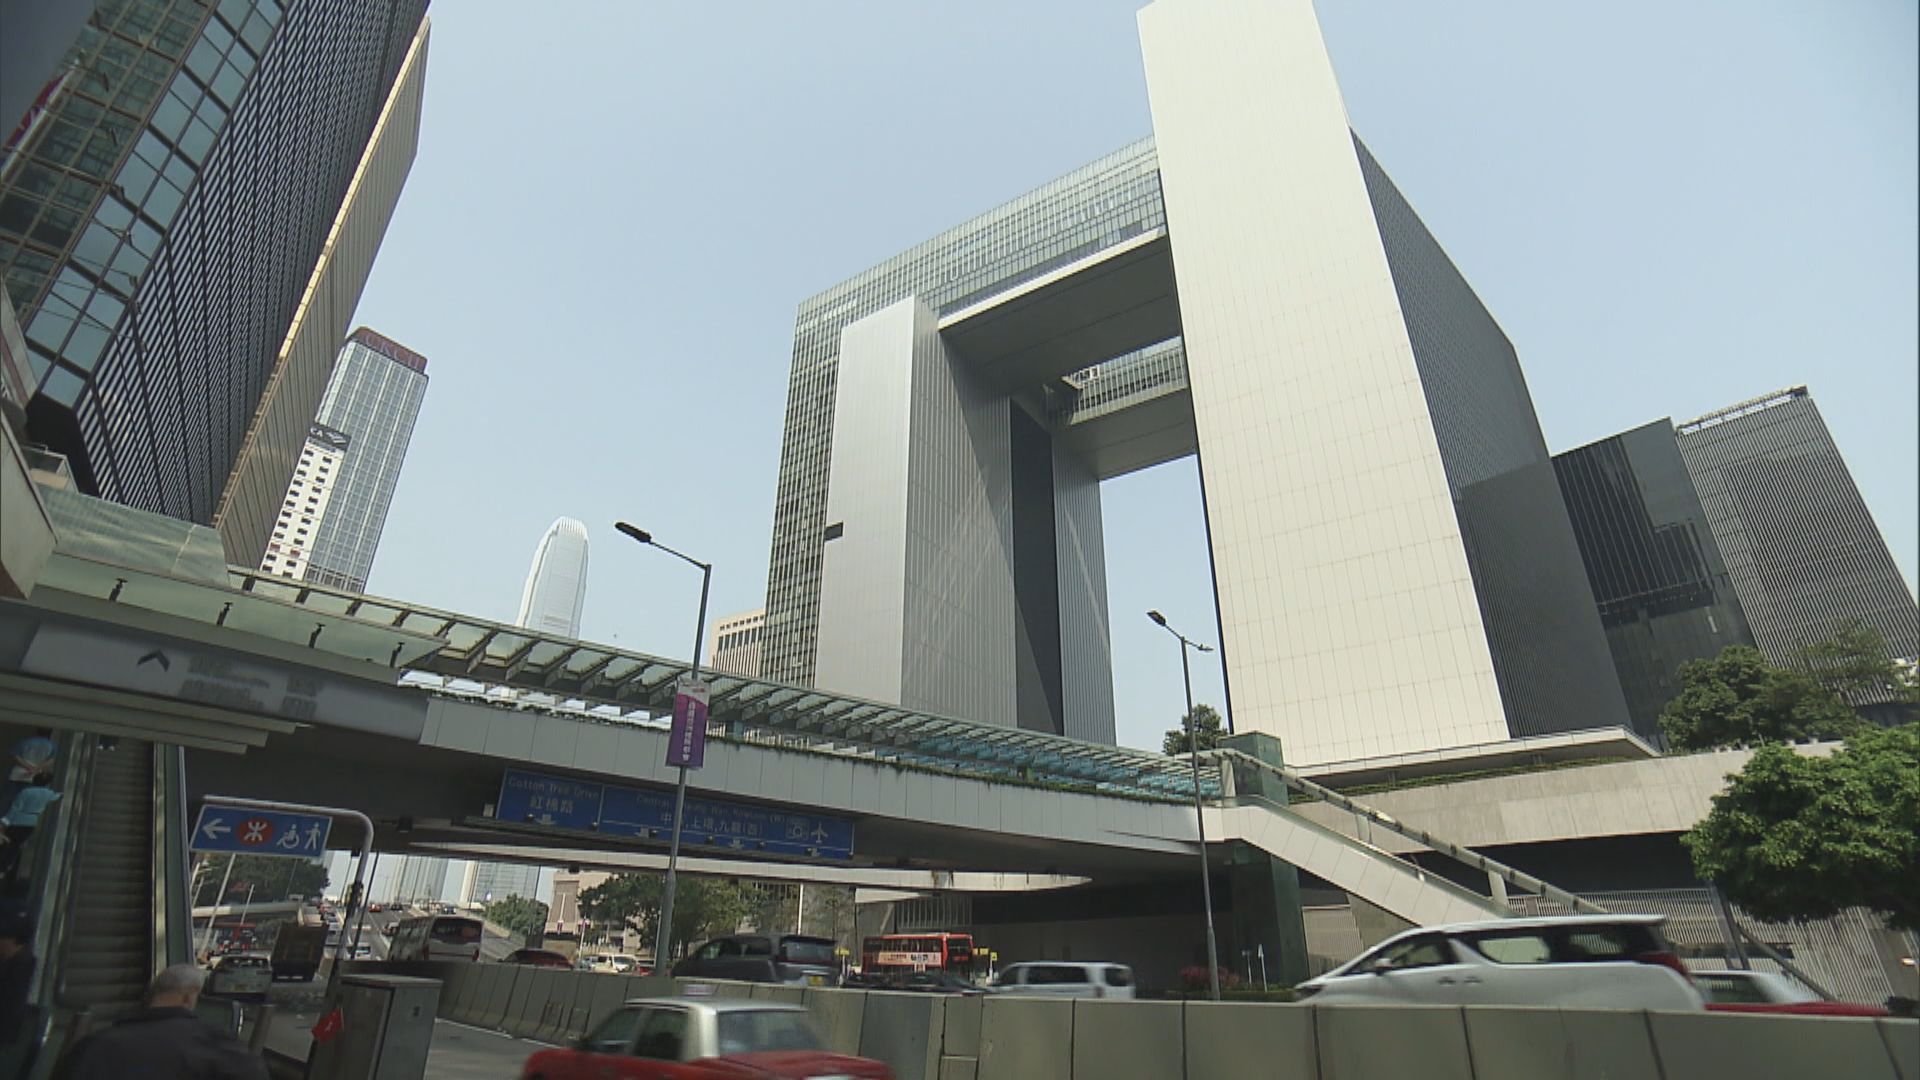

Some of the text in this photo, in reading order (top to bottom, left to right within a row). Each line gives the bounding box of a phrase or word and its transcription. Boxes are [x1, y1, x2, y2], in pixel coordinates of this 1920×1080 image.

[508, 776, 600, 800] Cotton Tree Drive
[529, 795, 574, 815] 紅棉路
